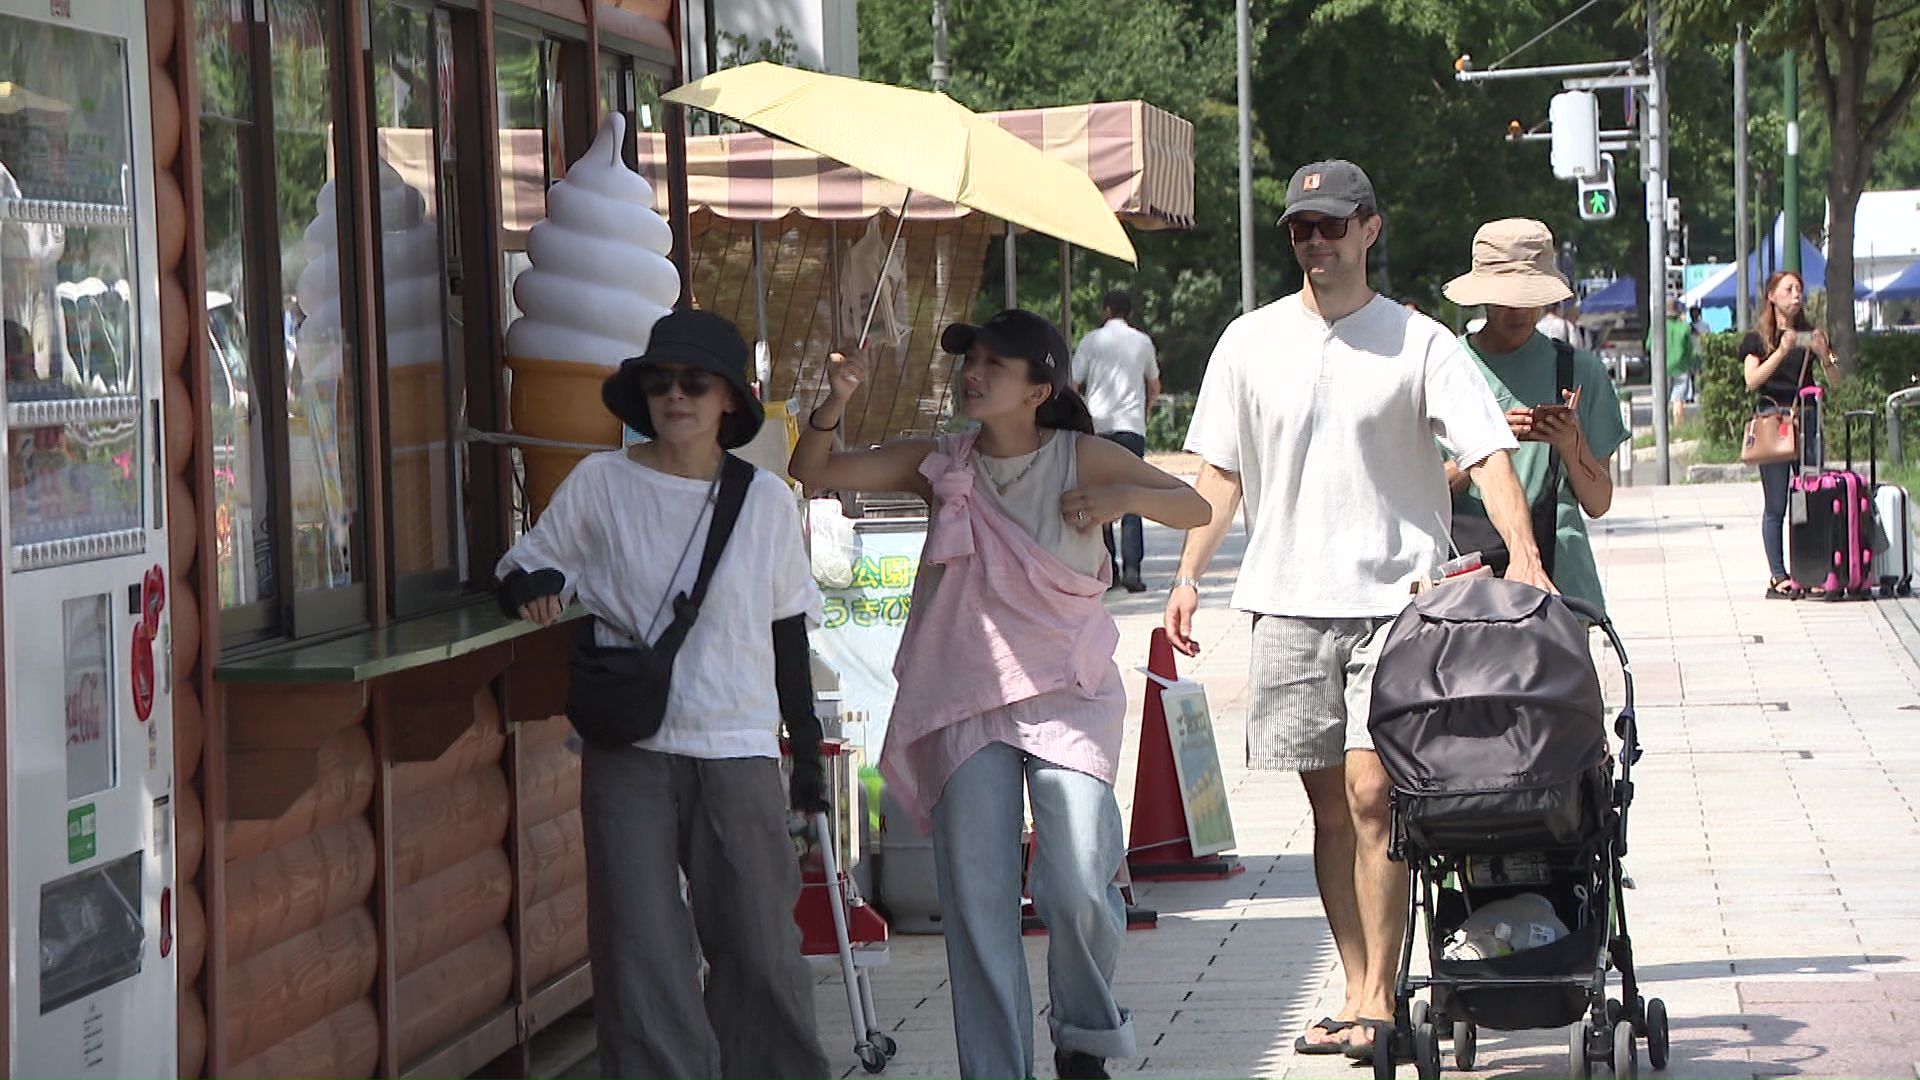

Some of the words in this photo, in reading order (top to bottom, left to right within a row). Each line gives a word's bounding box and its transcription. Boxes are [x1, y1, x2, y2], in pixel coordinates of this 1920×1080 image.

[851, 555, 918, 589] 公園
[823, 594, 912, 628] うきび
